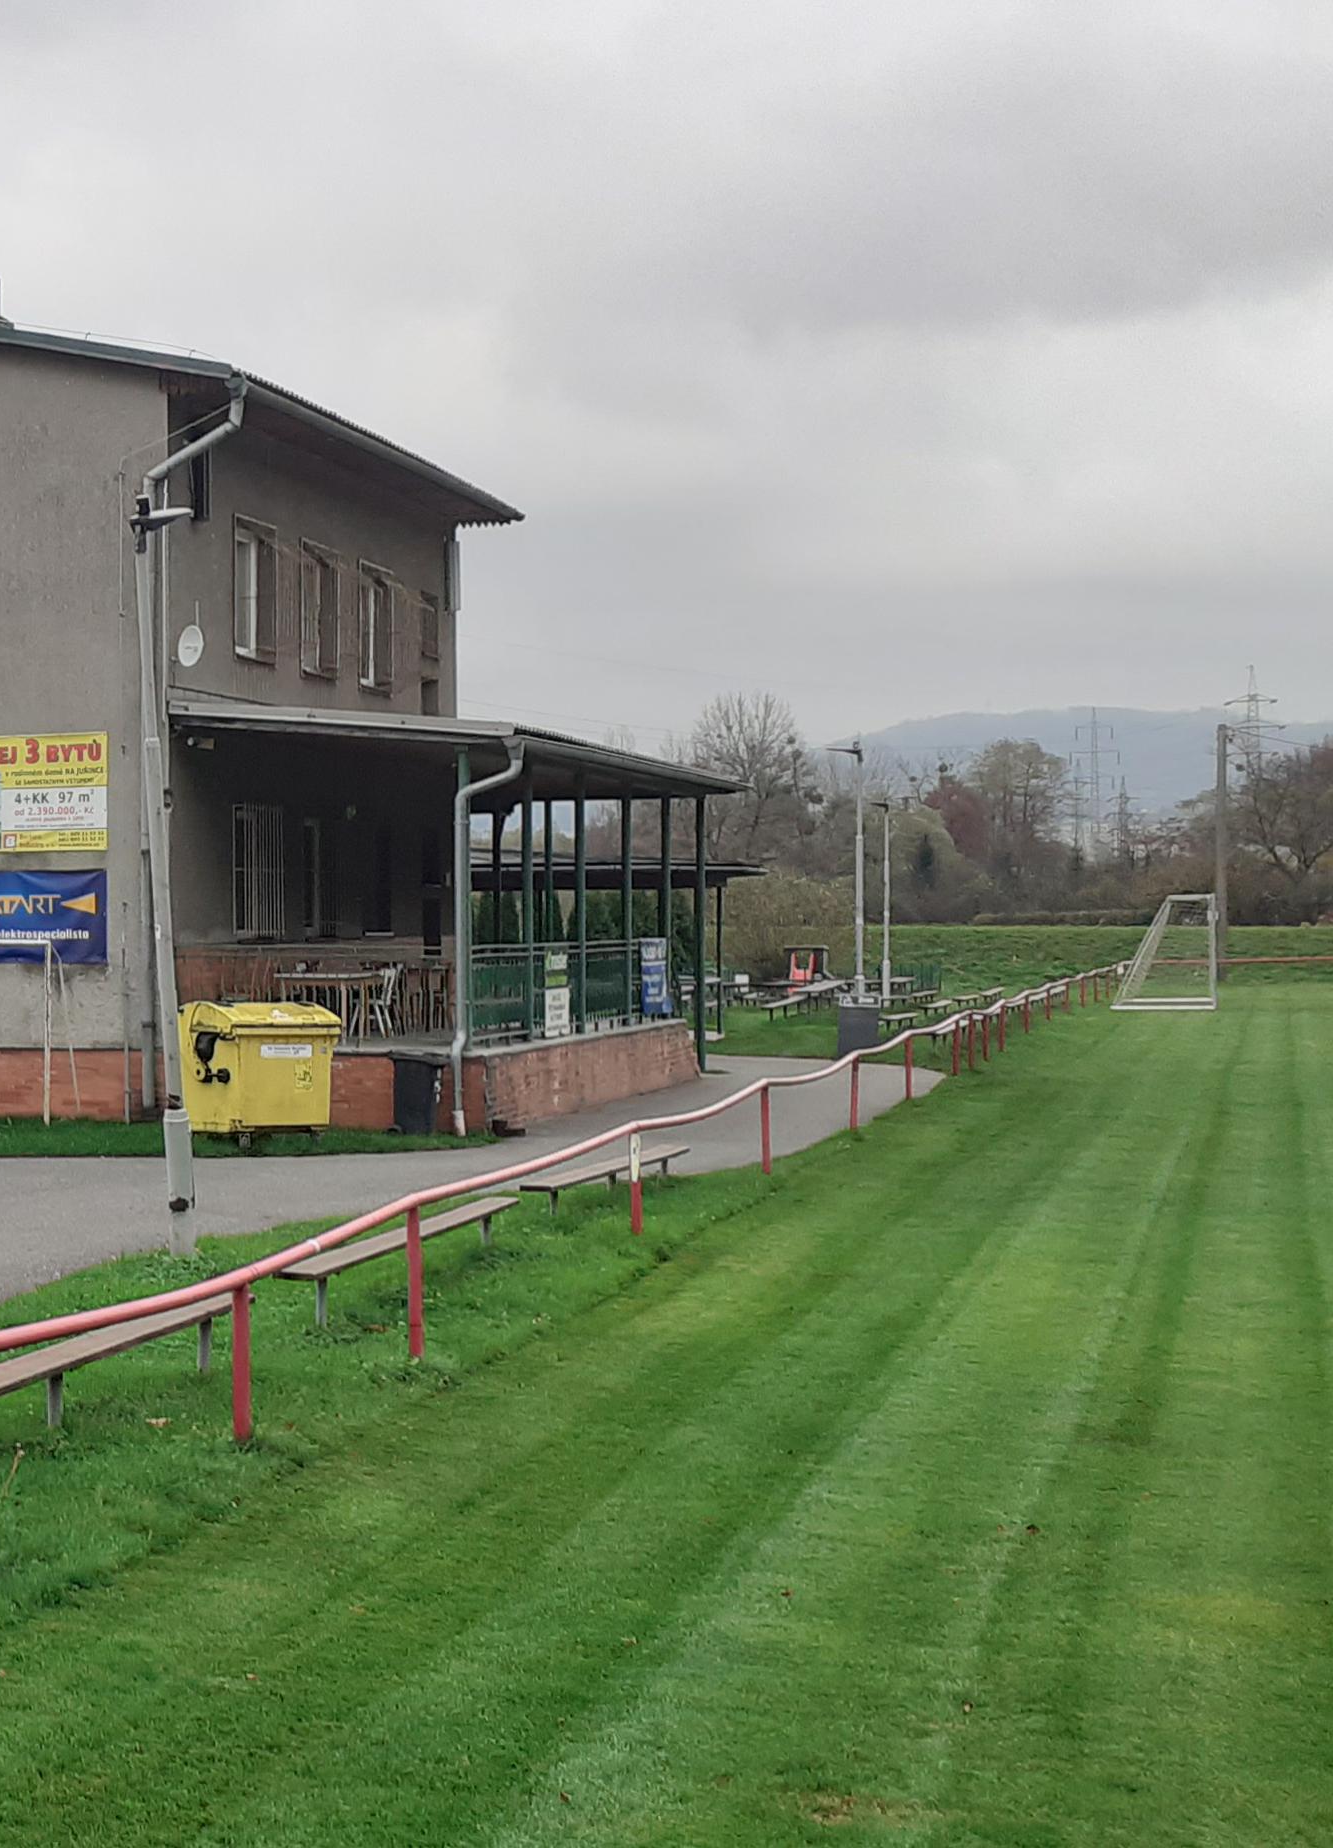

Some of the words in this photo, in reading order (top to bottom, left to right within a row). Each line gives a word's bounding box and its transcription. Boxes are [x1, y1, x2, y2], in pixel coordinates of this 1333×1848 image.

[25, 738, 40, 764] 3
[46, 739, 102, 763] BYTŮ
[14, 792, 50, 804] 4+KK
[58, 791, 74, 803] 97
[14, 808, 25, 816] od
